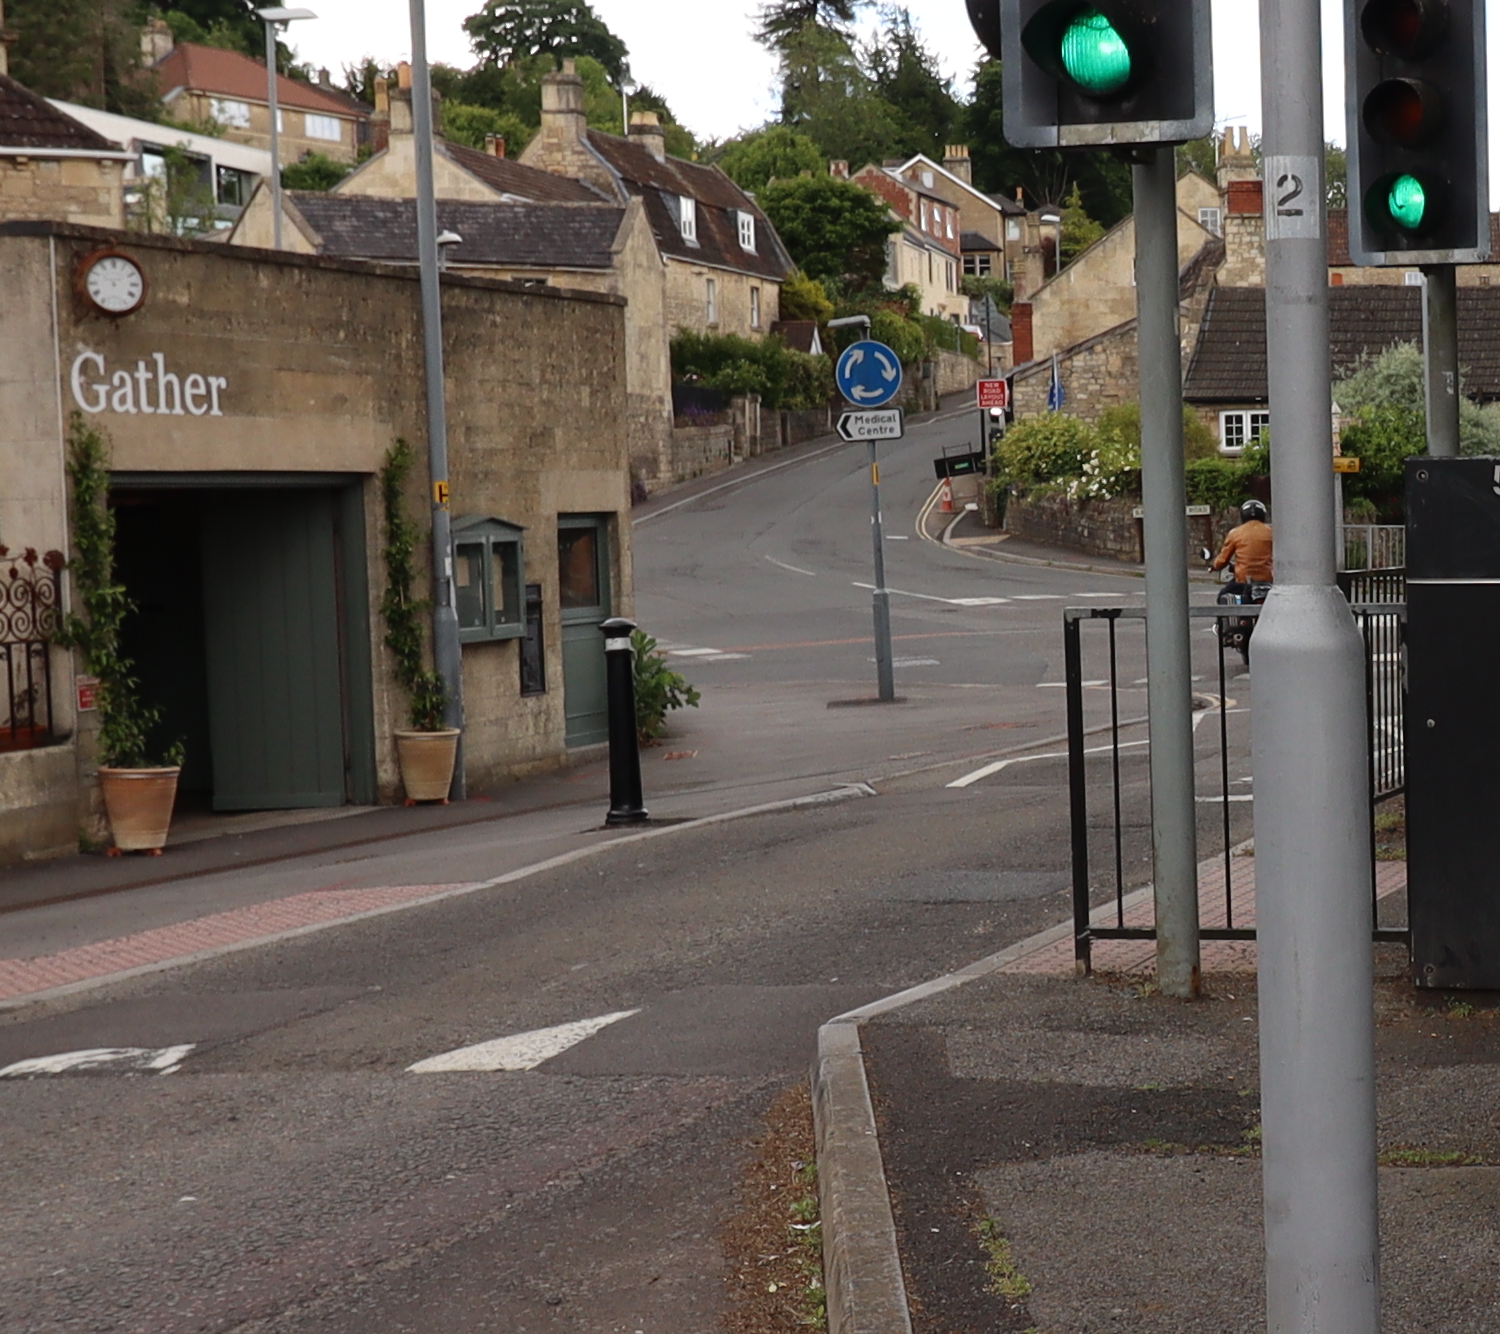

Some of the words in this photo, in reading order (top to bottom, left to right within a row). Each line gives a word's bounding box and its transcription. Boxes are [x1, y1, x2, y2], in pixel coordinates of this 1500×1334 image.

[1276, 174, 1304, 217] 2
[71, 351, 228, 417] Gather
[854, 413, 897, 425] Medical
[857, 425, 895, 436] Centre
